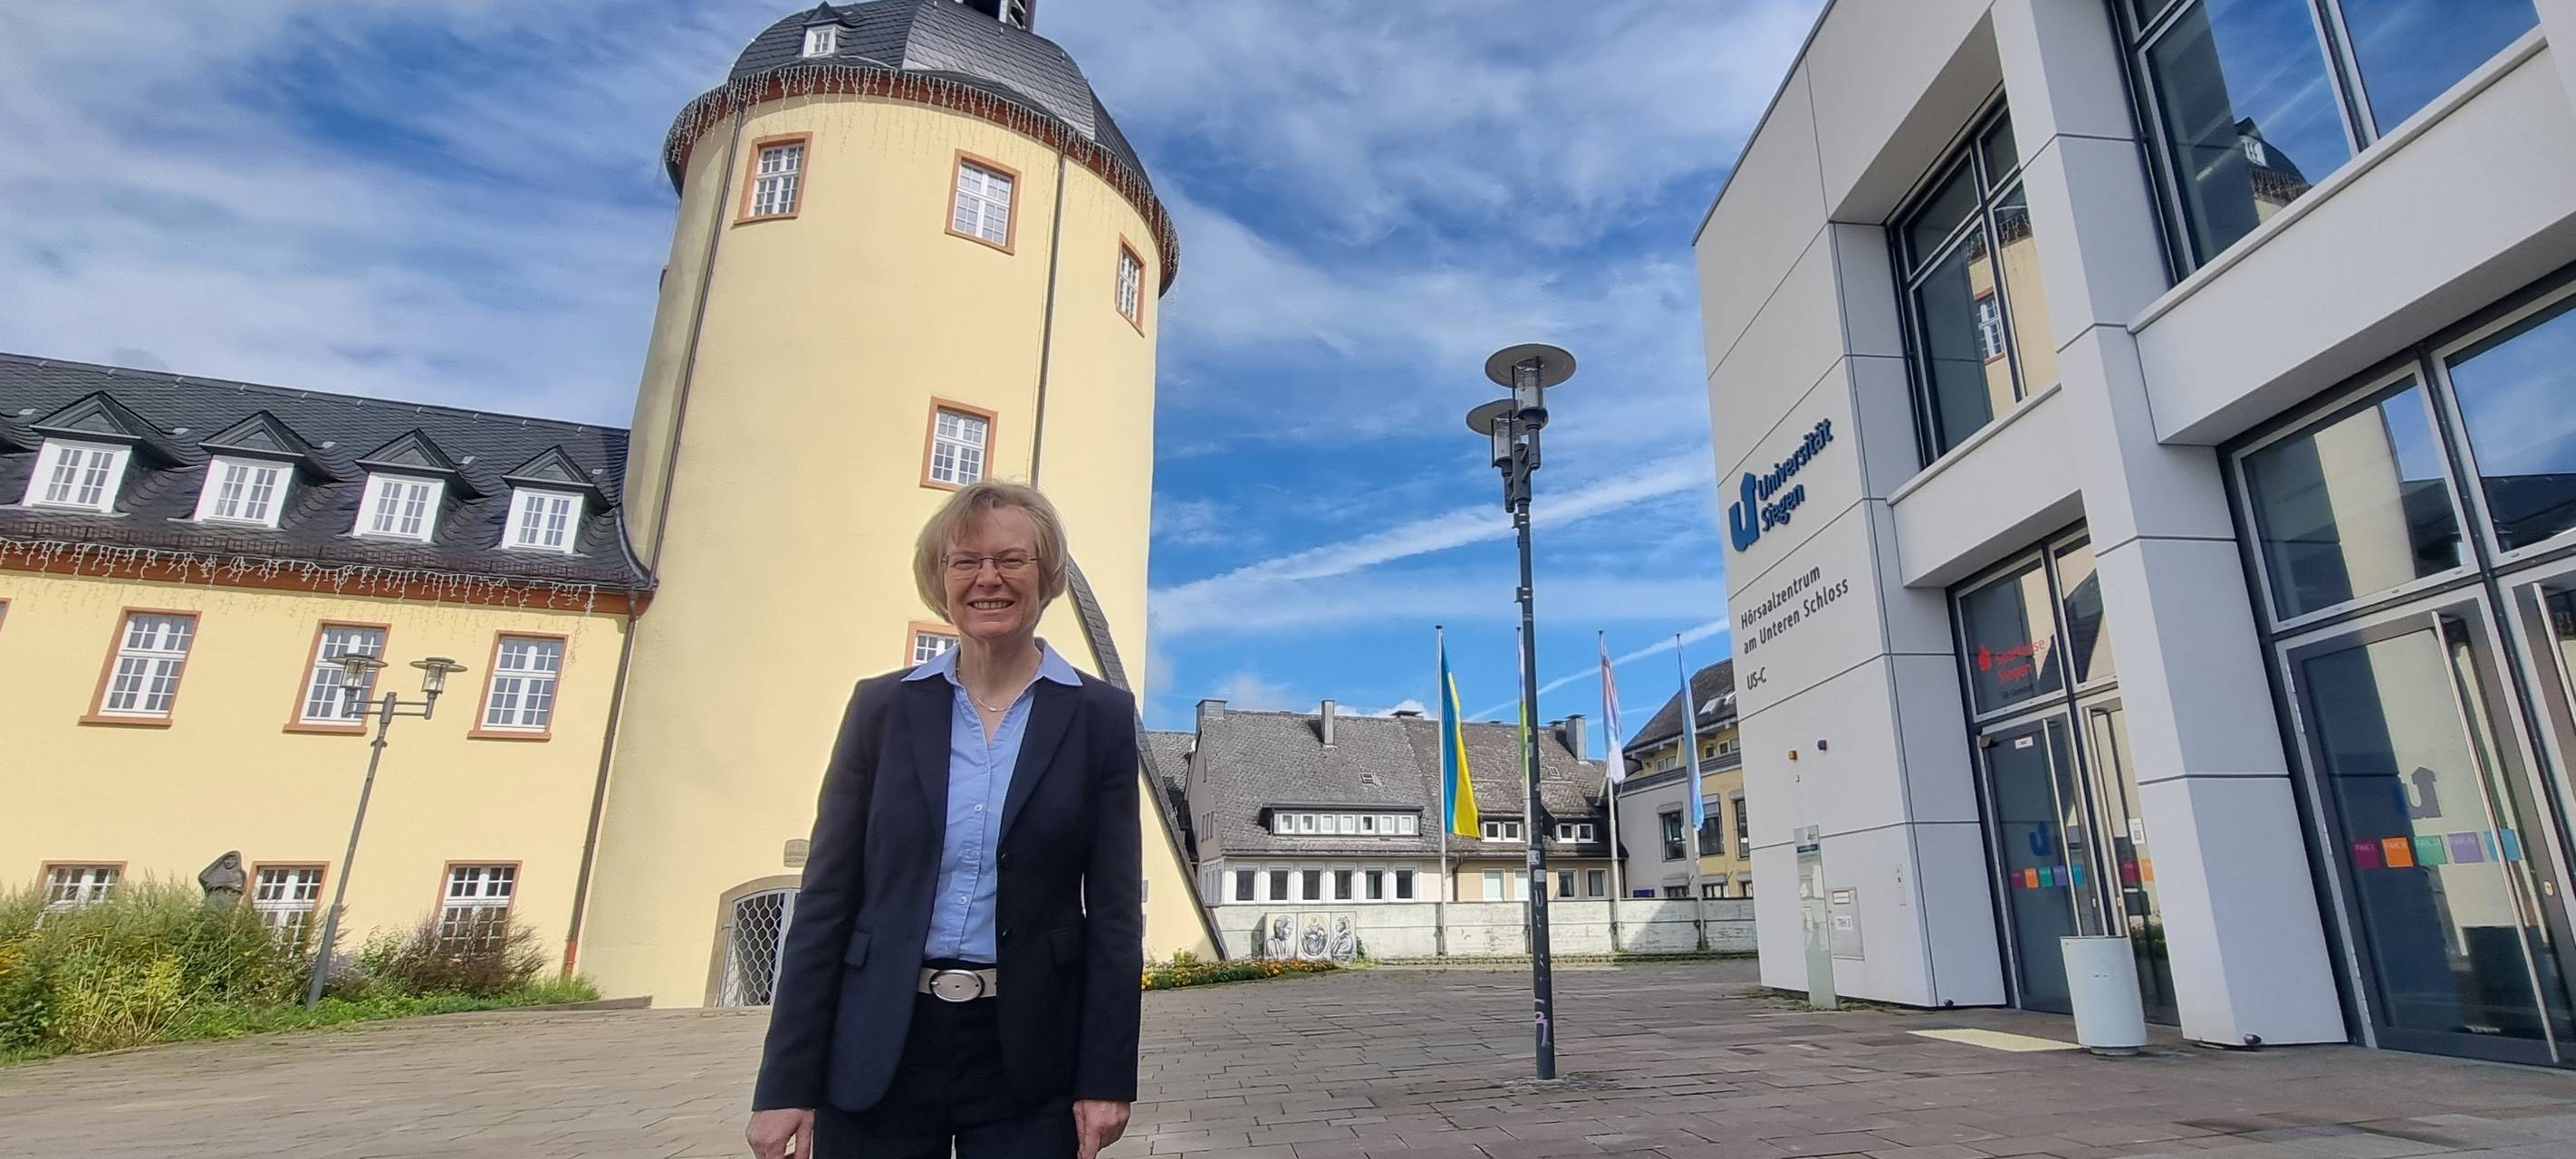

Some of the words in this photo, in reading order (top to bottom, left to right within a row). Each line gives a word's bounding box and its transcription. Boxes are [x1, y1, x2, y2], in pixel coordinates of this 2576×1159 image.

[1757, 417, 1833, 501] Universität
[1761, 484, 1805, 532] Siegen
[1740, 566, 1821, 630] Hörsaalzentrum
[1744, 637, 1757, 654] am
[1759, 608, 1800, 645] Unteren
[1802, 579, 1849, 618] Schloss
[1746, 666, 1767, 690] US-C
